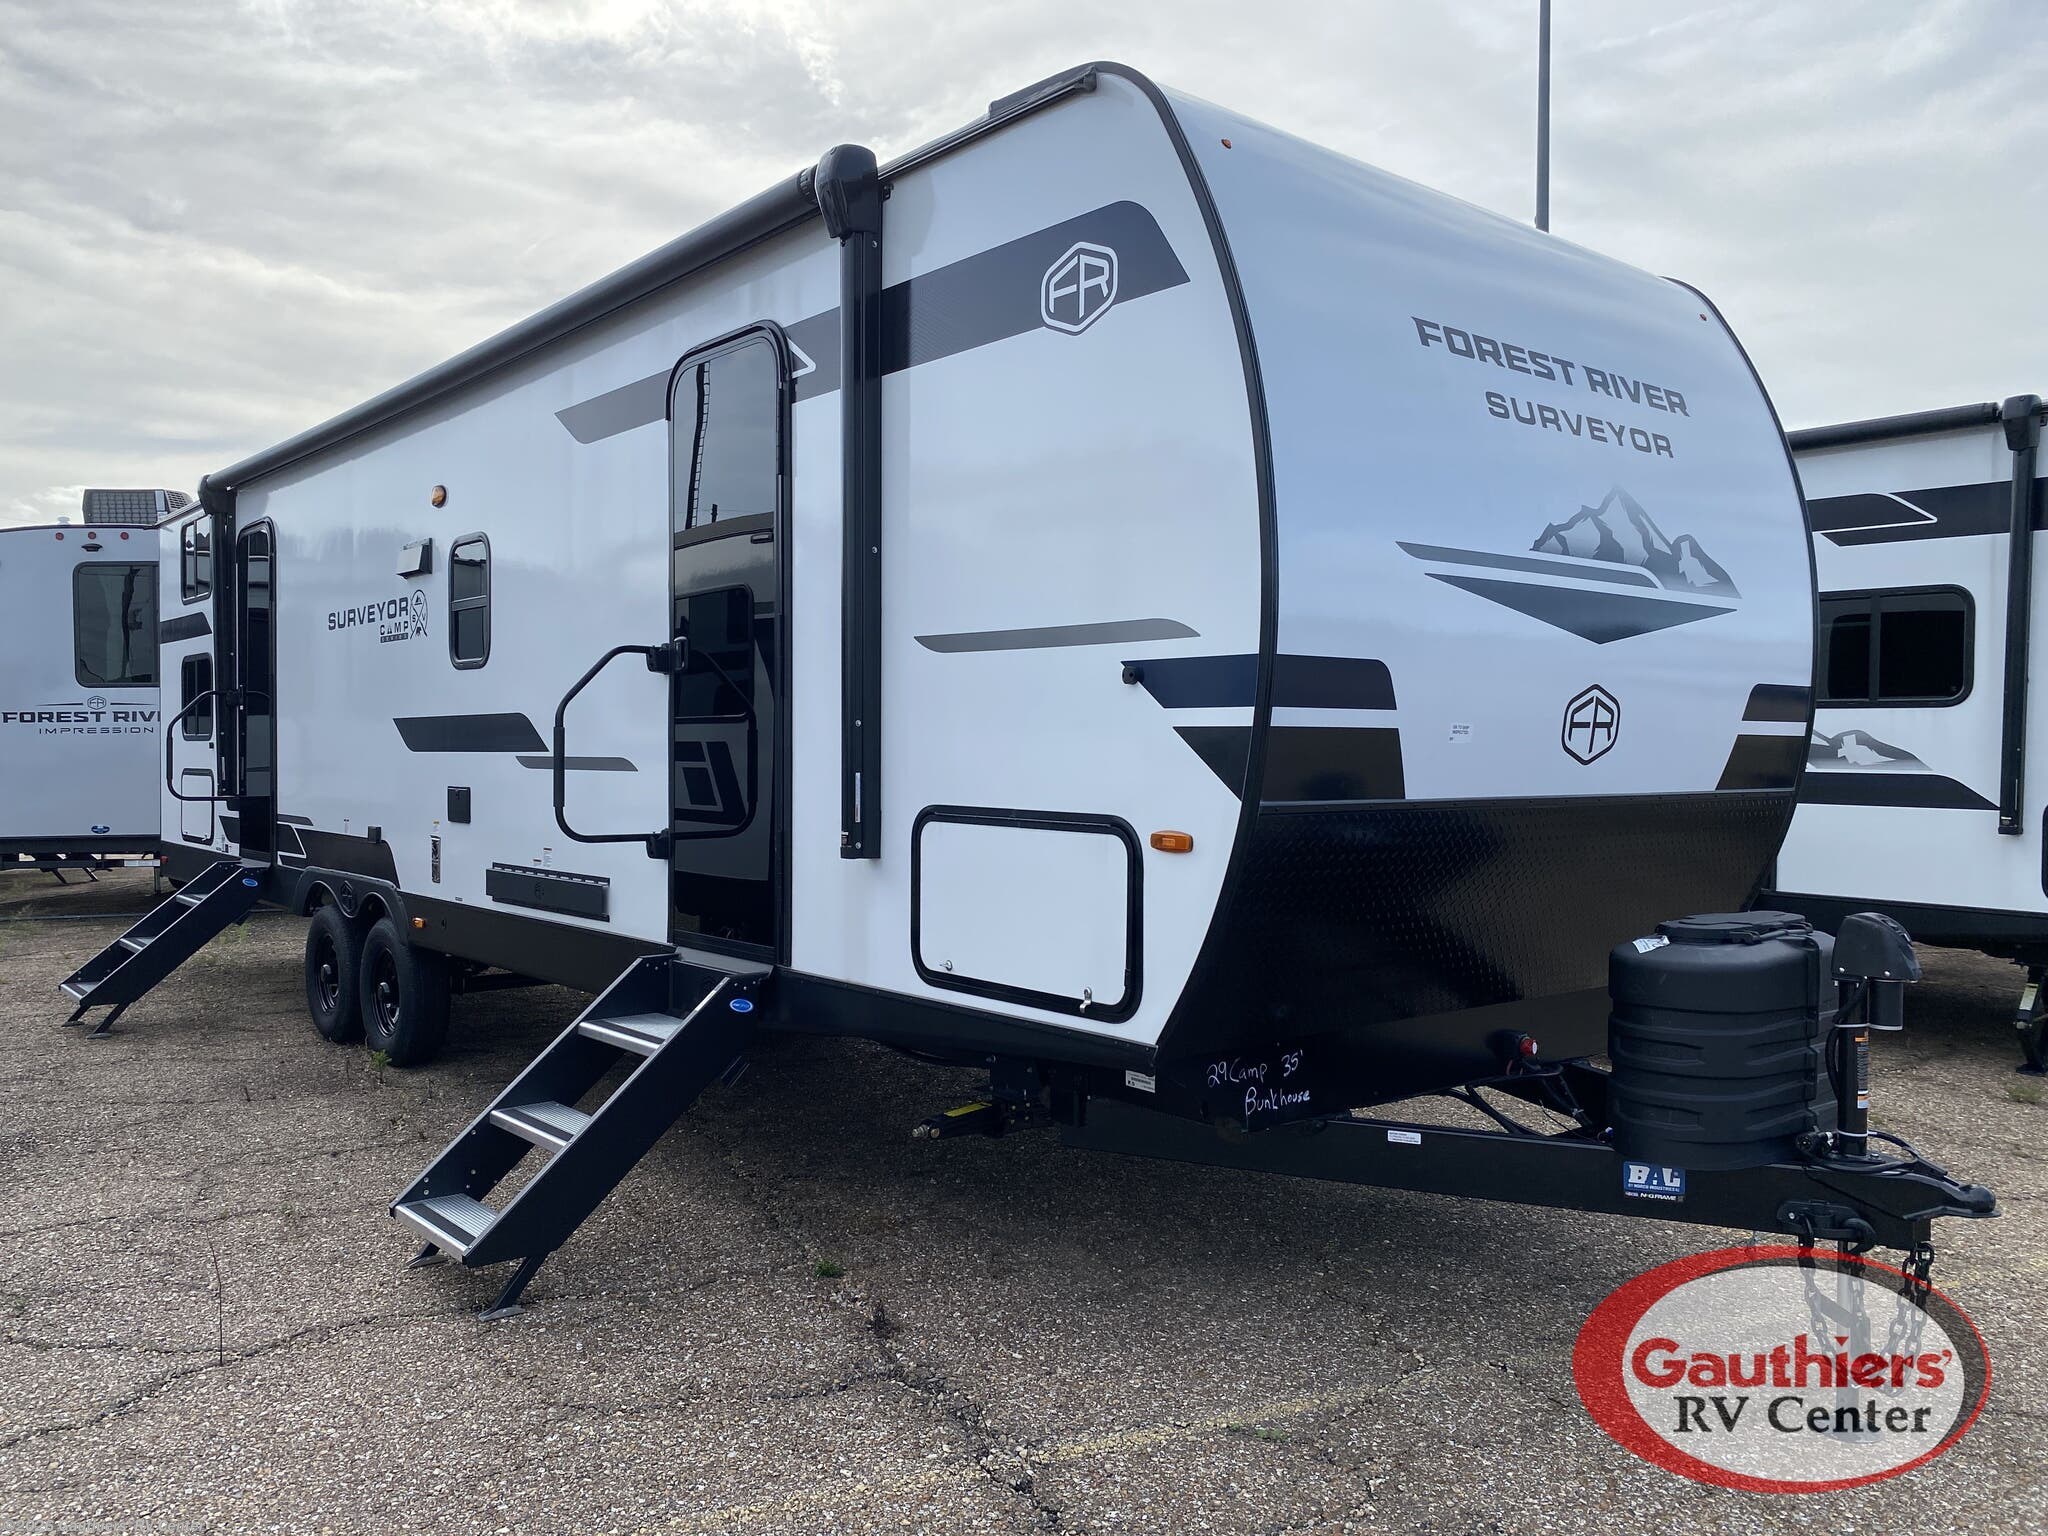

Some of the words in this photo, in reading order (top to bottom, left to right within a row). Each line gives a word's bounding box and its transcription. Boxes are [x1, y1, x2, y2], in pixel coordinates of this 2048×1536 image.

[1411, 316, 1575, 386] FOREST
[1582, 365, 1691, 417] RIVER
[1485, 391, 1674, 459] SURVEYOR
[328, 596, 409, 631] SURVEYOR
[379, 620, 409, 636] CAMP
[2, 711, 107, 724] FOREST
[112, 710, 161, 723] RIV
[39, 727, 154, 735] IMPRESSION
[1245, 1086, 1311, 1117] Bunkhouse
